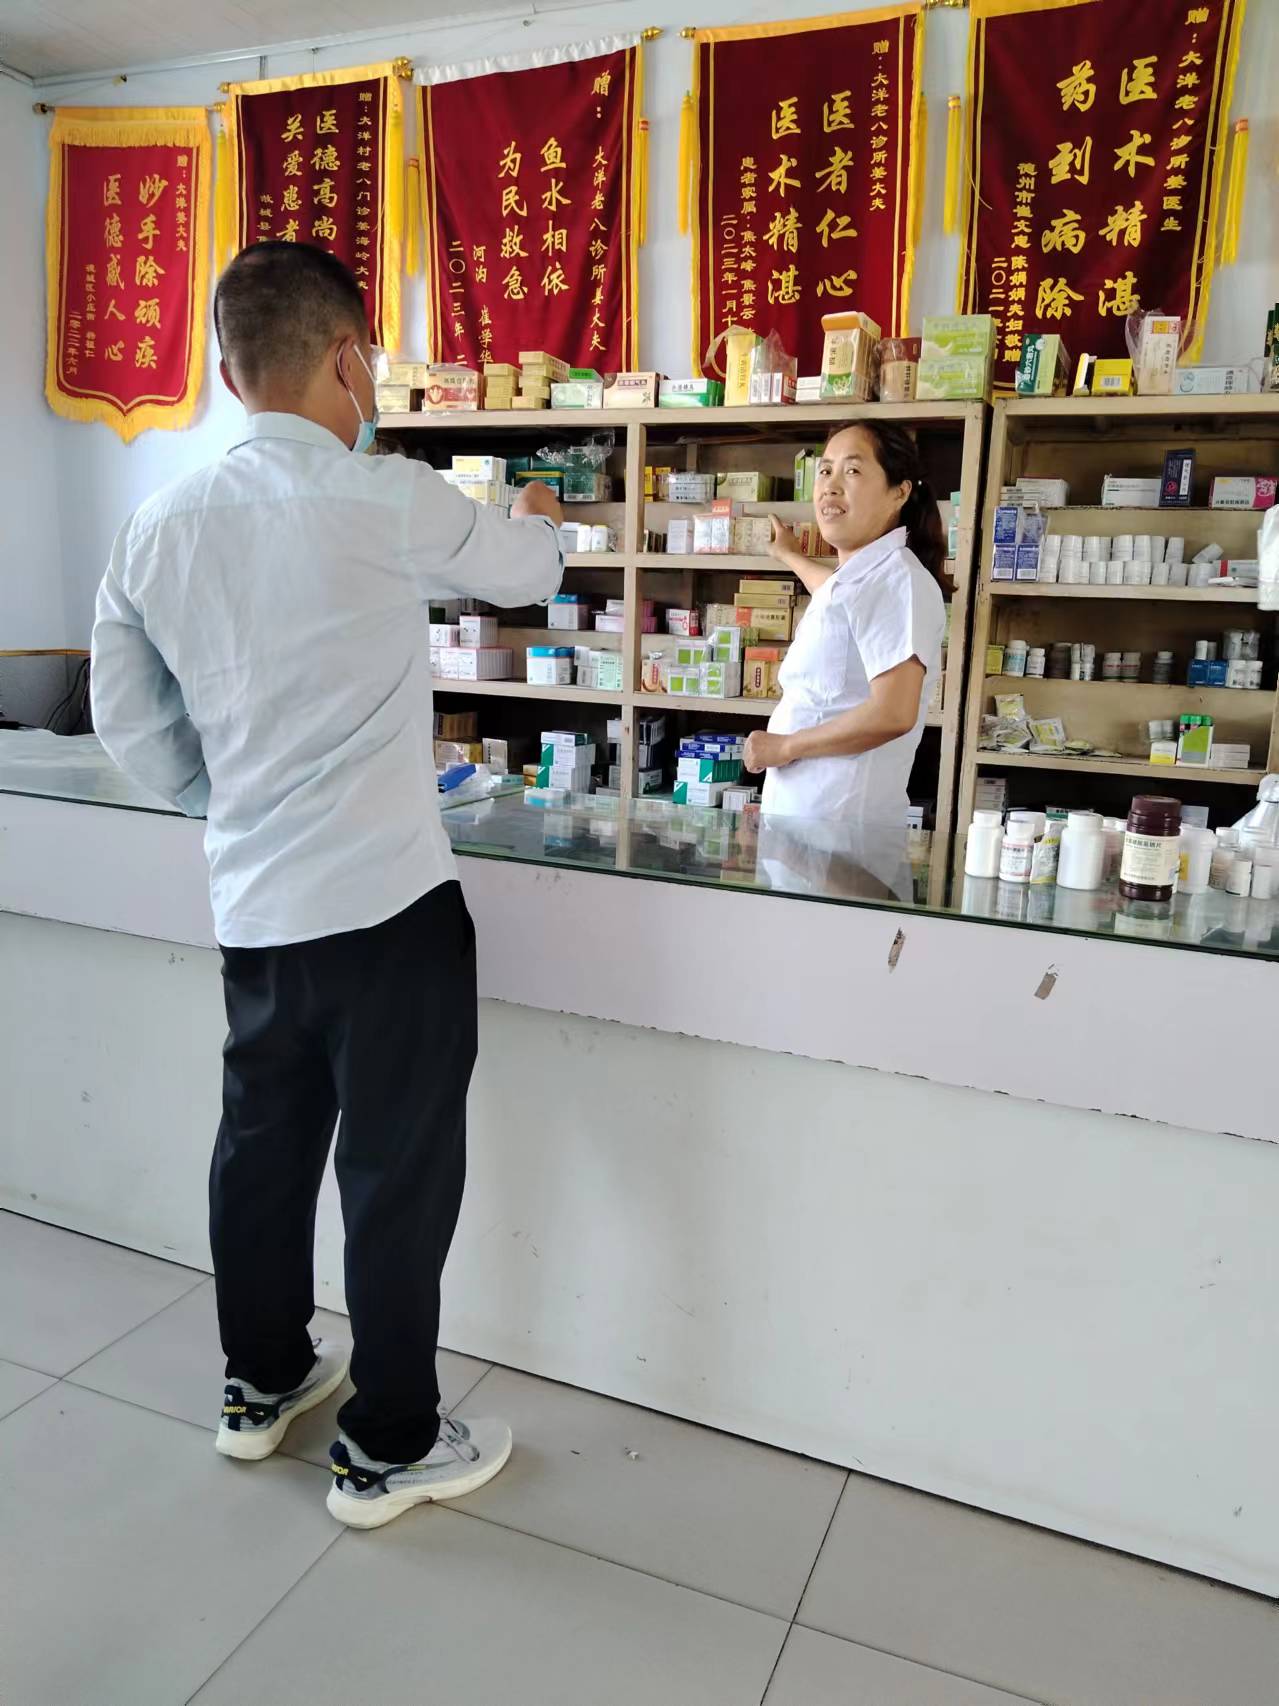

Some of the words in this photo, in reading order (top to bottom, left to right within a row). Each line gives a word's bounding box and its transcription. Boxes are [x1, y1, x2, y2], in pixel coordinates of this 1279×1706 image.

[103, 174, 126, 361] 医德感人心
[134, 173, 169, 369] 妙手除顽疾
[275, 113, 304, 243] 关爱患者
[310, 109, 341, 254] 医德高尚
[497, 140, 529, 300] 为民救急
[540, 136, 572, 296] 鱼水相依
[762, 96, 803, 305] 医术精湛
[815, 90, 858, 297] 医者仁心
[1035, 60, 1097, 320] 药到病除
[1097, 55, 1159, 318] 医术精湛
